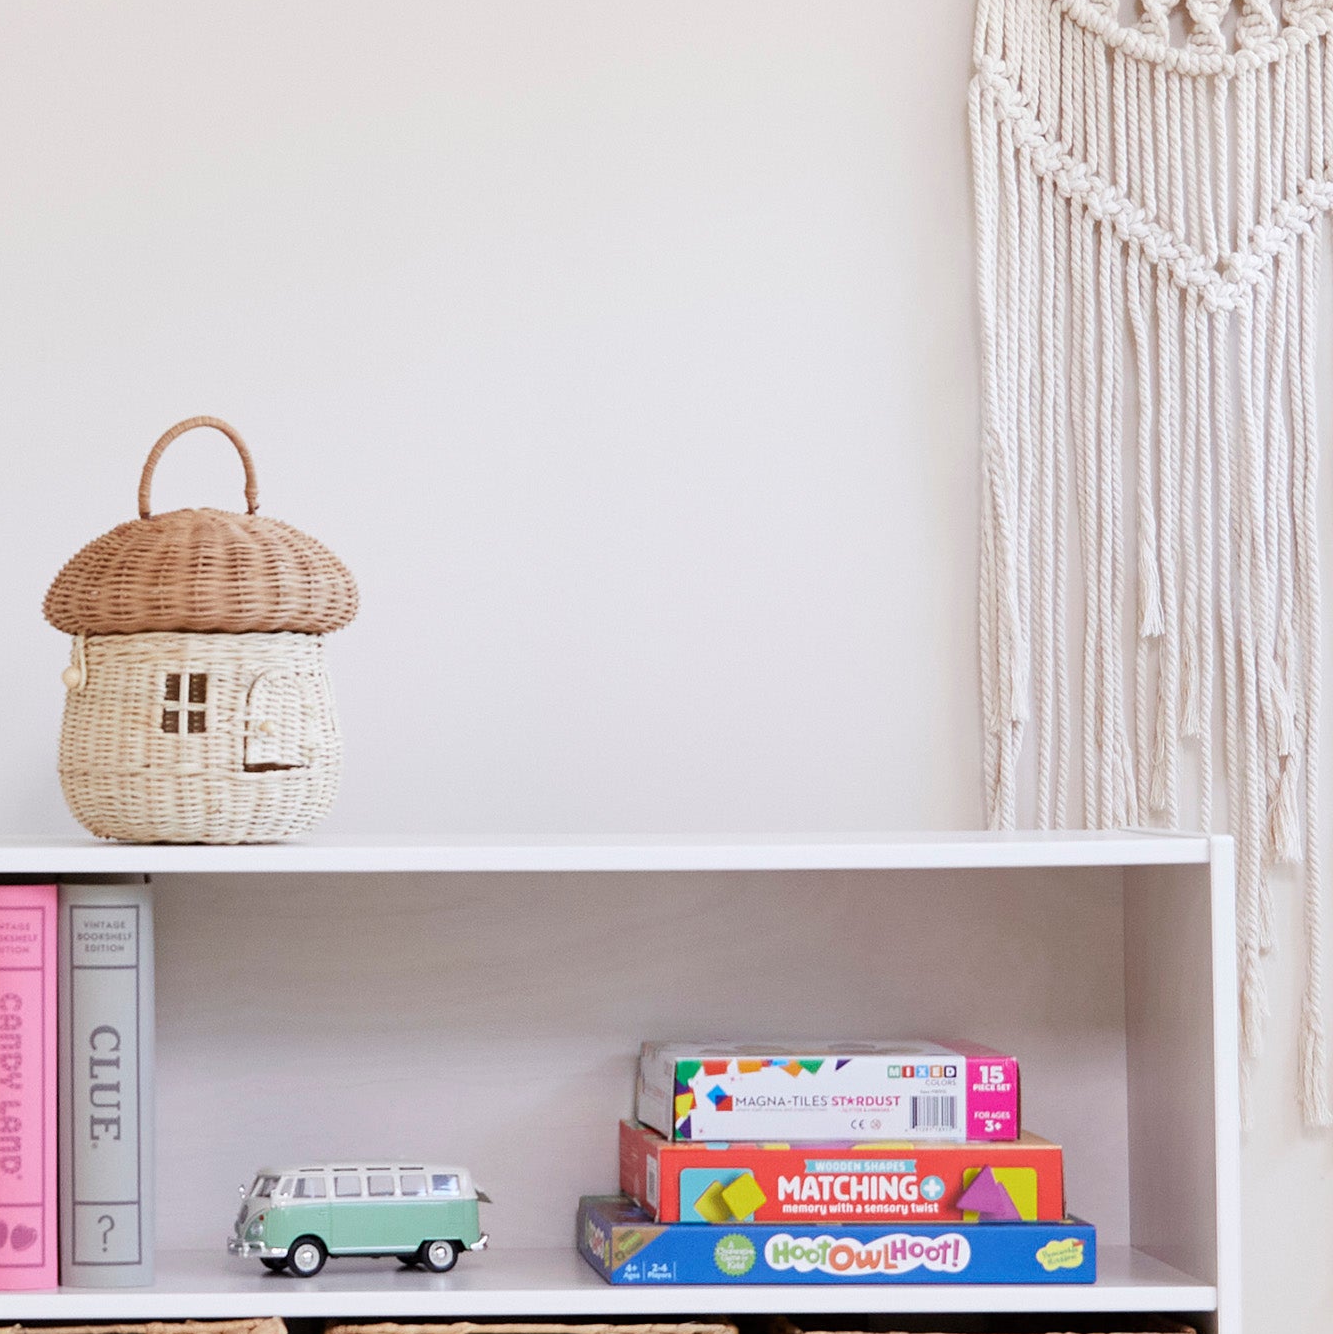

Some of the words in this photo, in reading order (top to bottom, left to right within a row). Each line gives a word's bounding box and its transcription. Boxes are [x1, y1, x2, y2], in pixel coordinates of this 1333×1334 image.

[83, 920, 127, 930] VINTAGE
[84, 943, 125, 954] EDITION
[888, 1065, 957, 1079] MIXED
[979, 1065, 1005, 1085] 15
[89, 1024, 123, 1142] CLUE
[925, 1079, 957, 1087] COLORS
[973, 1084, 995, 1092] PIECE
[996, 1083, 1012, 1092] SET
[735, 1094, 828, 1107] MAGNA-TILES
[974, 1111, 990, 1120] FOR
[991, 1111, 1011, 1120] AGES
[984, 1120, 1002, 1133] 3+
[814, 1161, 861, 1173] WOODEN
[863, 1161, 906, 1173] SHAPES
[782, 1204, 828, 1216] memory
[829, 1202, 854, 1214] with
[855, 1204, 863, 1214] a
[864, 1203, 908, 1216] sensory
[910, 1202, 939, 1214] twist
